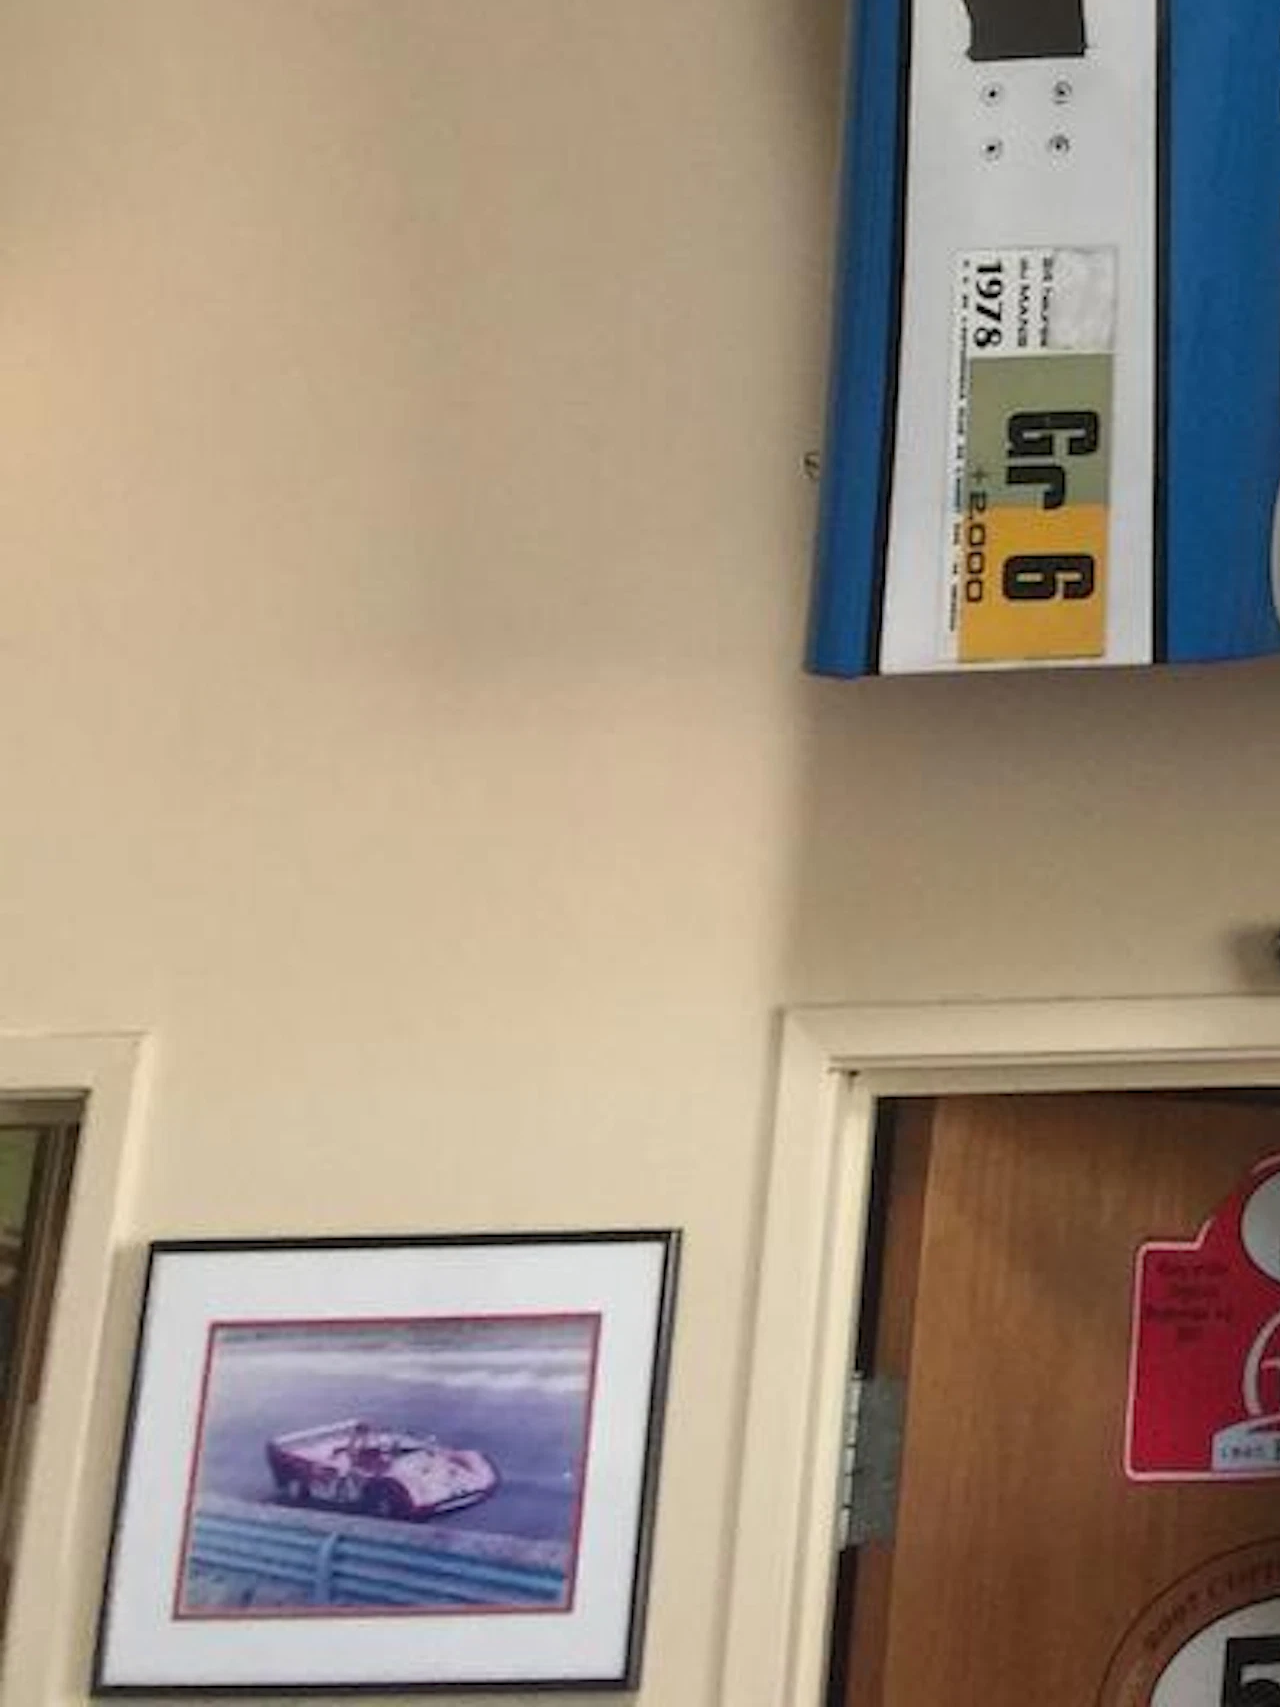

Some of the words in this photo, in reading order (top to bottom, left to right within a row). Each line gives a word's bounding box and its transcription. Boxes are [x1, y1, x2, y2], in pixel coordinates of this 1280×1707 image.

[973, 258, 1005, 350] 1978
[1005, 408, 1102, 511] Gr
[1002, 553, 1096, 603] 6
